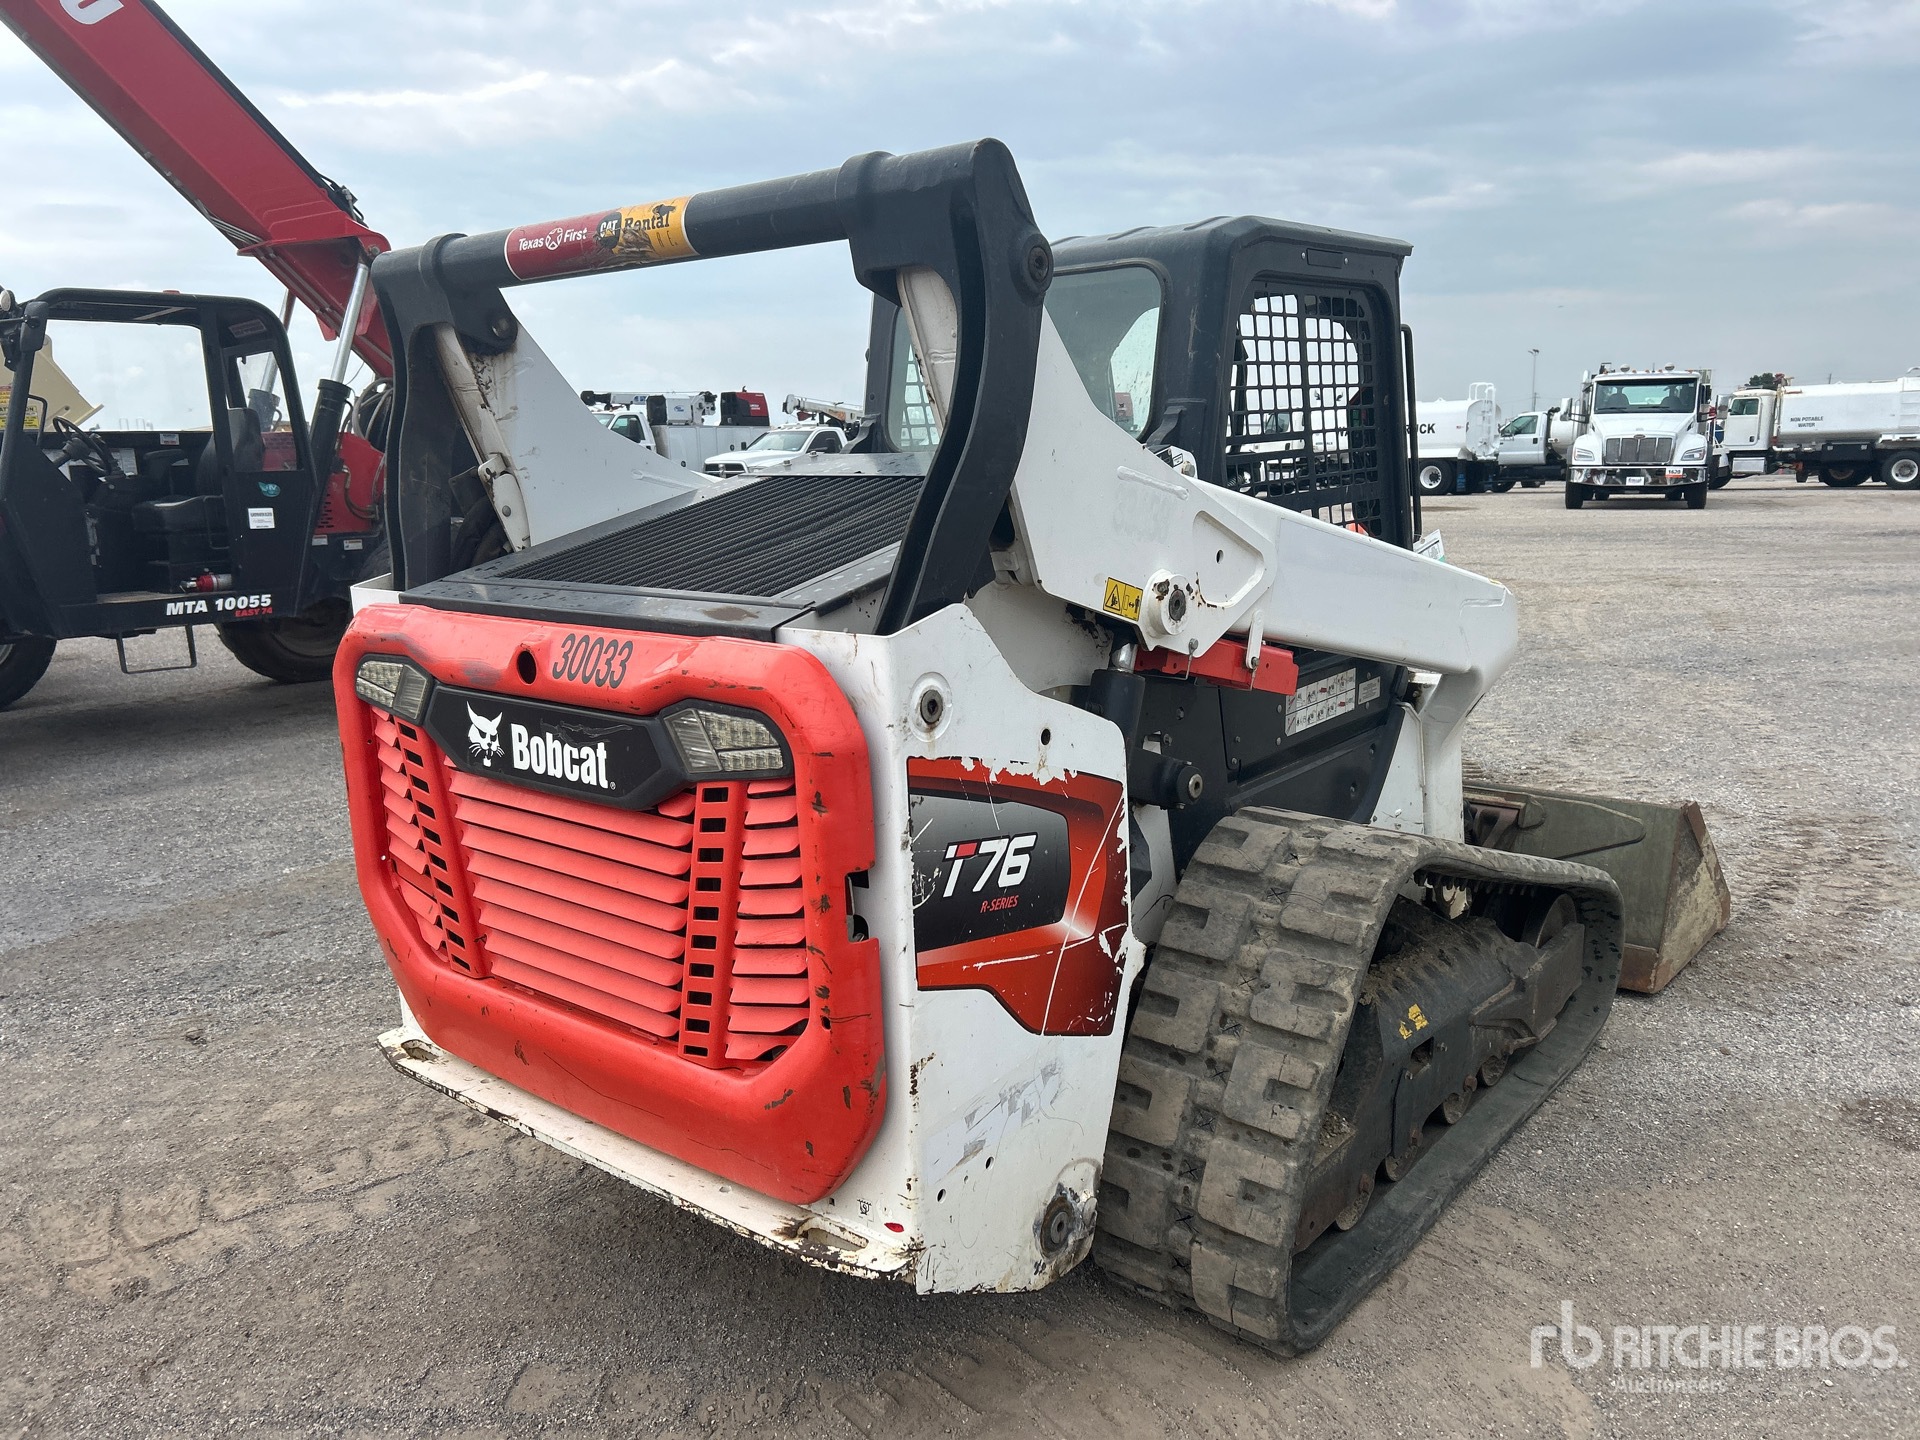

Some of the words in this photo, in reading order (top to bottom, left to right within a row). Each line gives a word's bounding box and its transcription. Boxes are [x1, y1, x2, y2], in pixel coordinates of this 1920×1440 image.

[518, 236, 544, 251] Texas
[563, 227, 588, 243] First
[600, 219, 618, 238] CAT
[166, 600, 208, 616] MTA
[215, 594, 272, 612] 10055
[235, 609, 259, 617] EASY
[261, 607, 273, 615] 74
[552, 633, 634, 689] 30033
[510, 723, 609, 789] Bobcat
[980, 894, 1020, 914] R-SERIES
